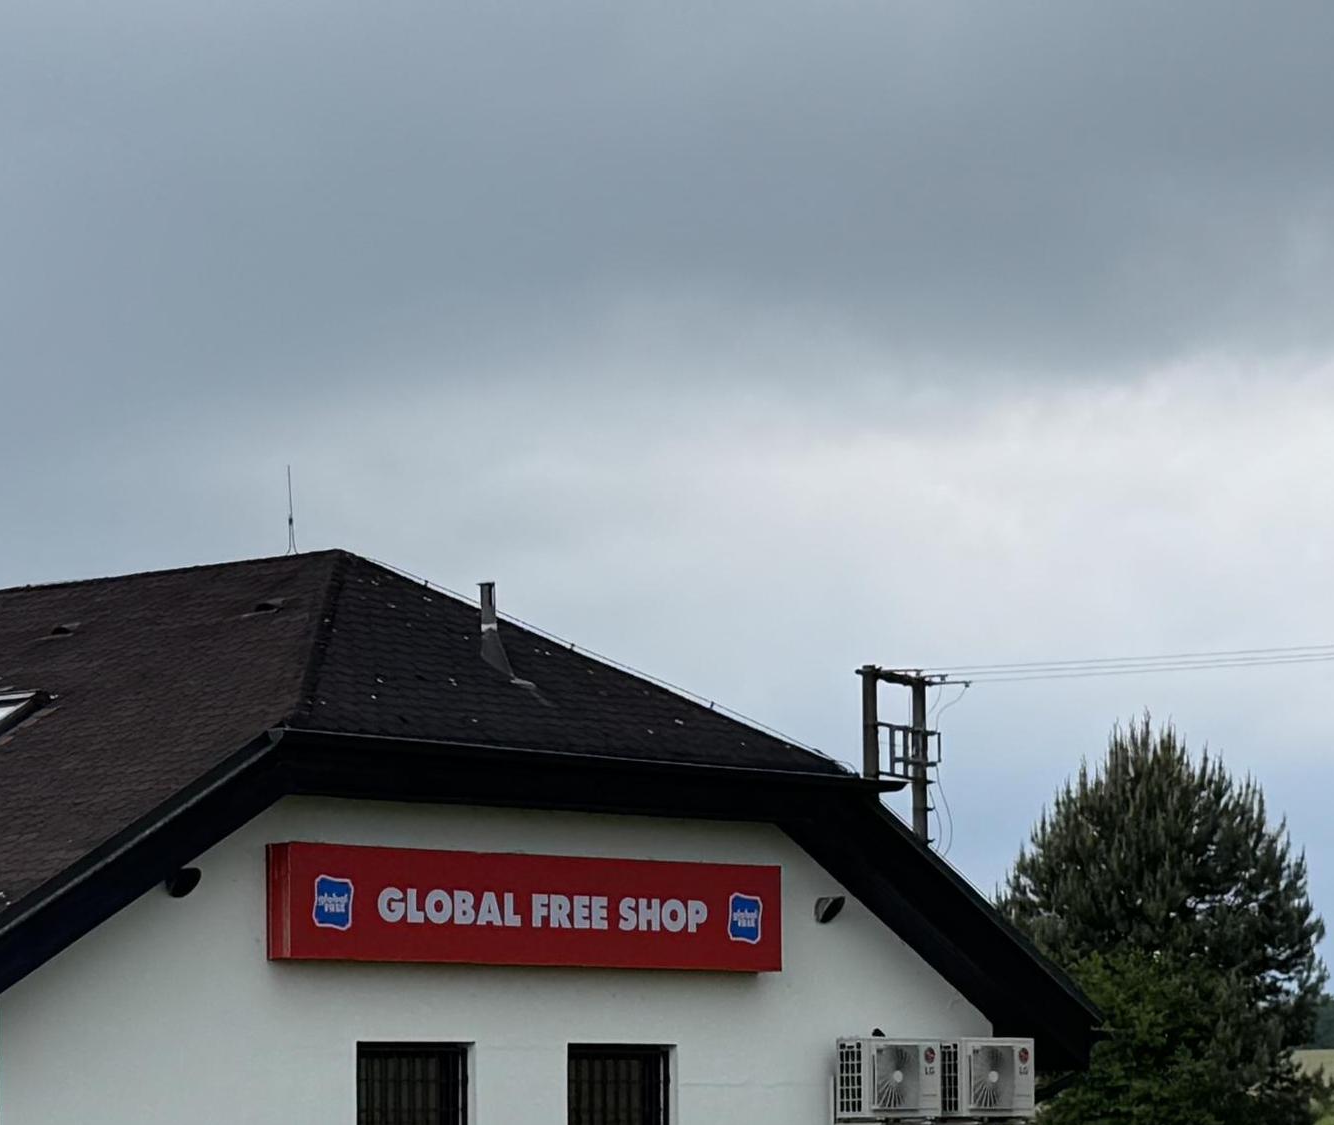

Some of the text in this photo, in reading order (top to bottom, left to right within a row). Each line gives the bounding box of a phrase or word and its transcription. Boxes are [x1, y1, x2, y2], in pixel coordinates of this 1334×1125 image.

[377, 887, 709, 934] GLOBAL FREE SHOP
